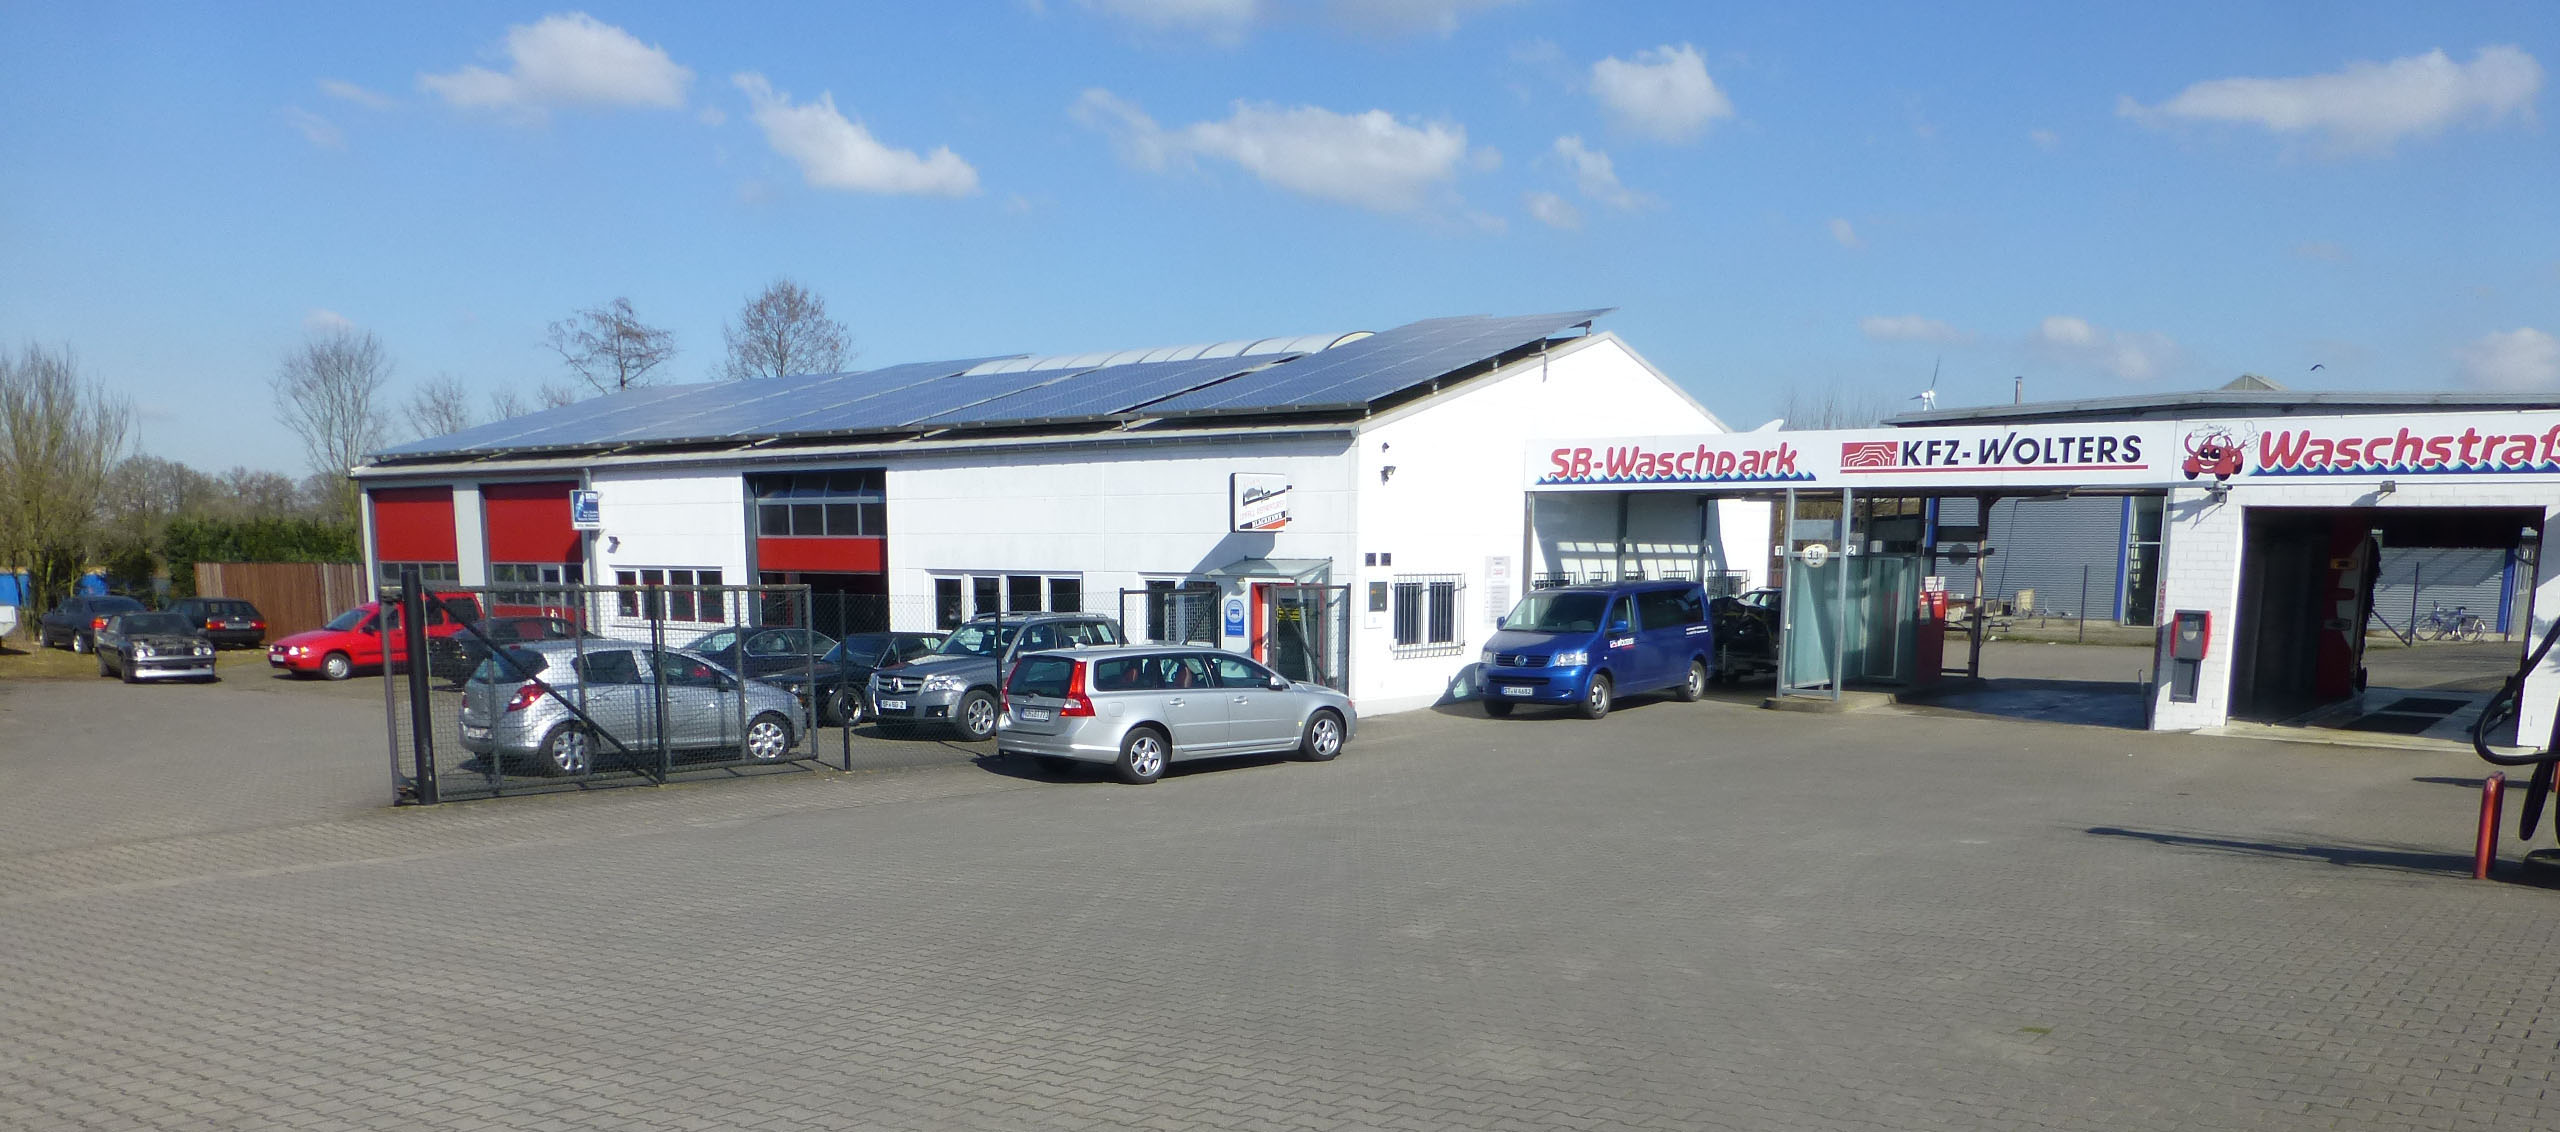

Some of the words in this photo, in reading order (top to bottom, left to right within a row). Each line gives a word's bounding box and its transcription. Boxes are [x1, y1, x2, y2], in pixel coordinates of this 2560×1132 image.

[1548, 442, 1797, 479] SB-Waschpark
[1901, 431, 2142, 466] KFZ-WOLTERS
[1848, 546, 1855, 555] 2
